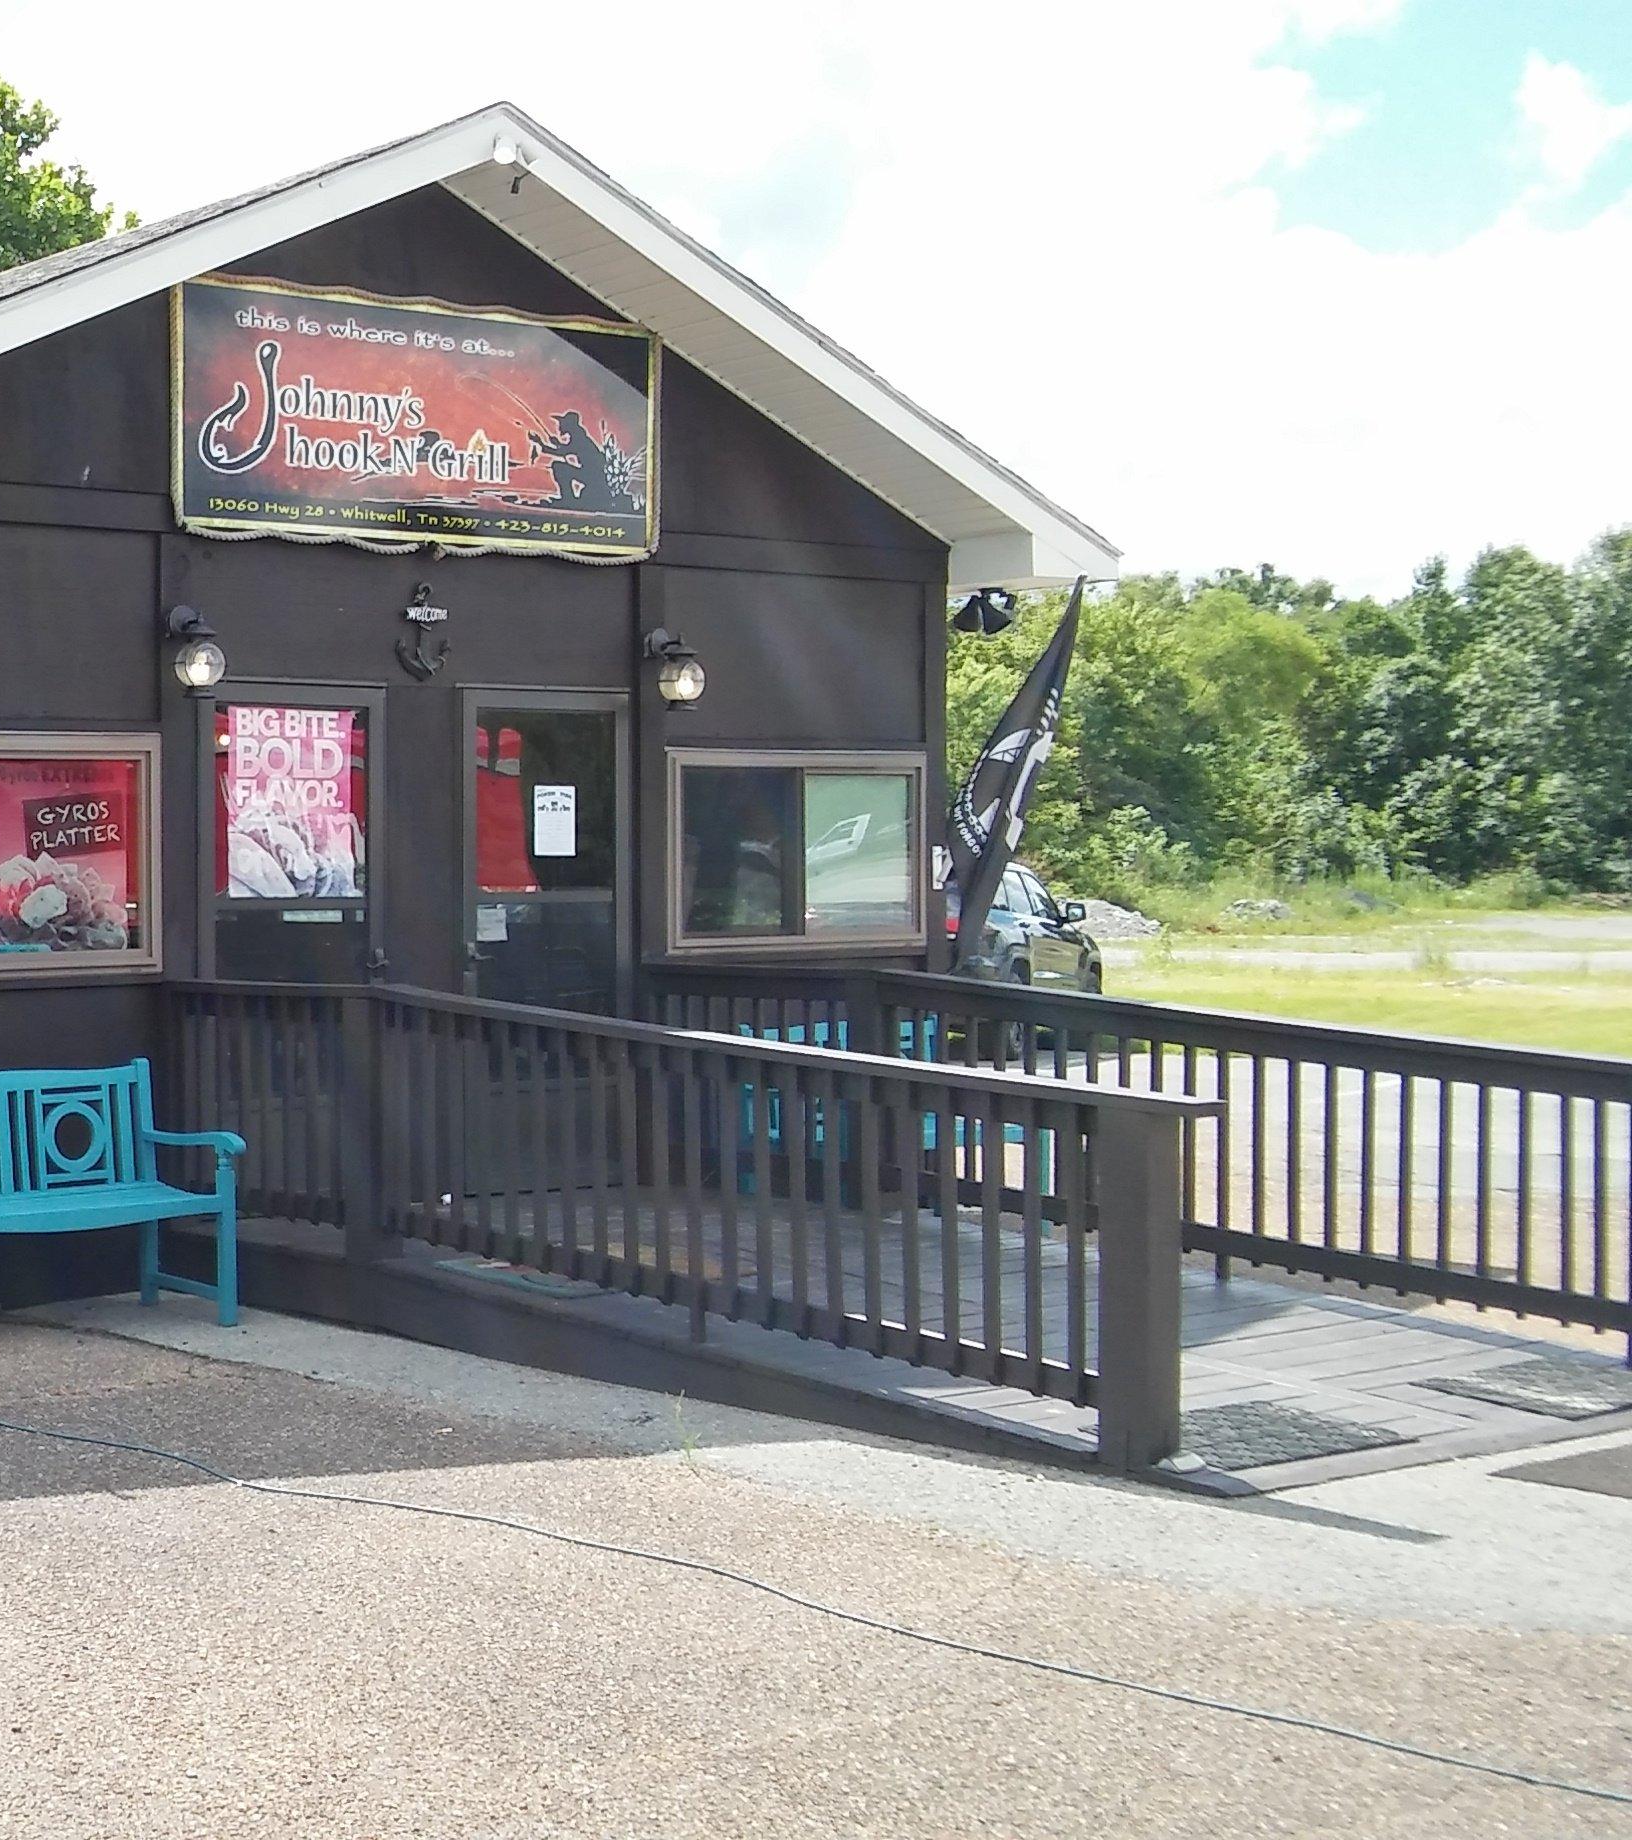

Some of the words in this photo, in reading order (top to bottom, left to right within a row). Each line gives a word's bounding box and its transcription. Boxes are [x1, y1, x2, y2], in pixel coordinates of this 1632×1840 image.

[235, 306, 290, 331] this
[296, 315, 321, 336] is
[327, 319, 408, 345] where
[414, 329, 455, 350] it's
[461, 339, 515, 358] at...
[199, 339, 425, 475] Johnny's
[429, 429, 511, 484] Grill
[208, 498, 260, 513] 13060
[264, 502, 300, 519] Hwy
[304, 505, 325, 517] 28
[341, 508, 412, 525] Whitwell,
[417, 513, 438, 525] Tn
[442, 516, 480, 529] 37397
[495, 518, 626, 538] 423-815-4014
[235, 708, 281, 737] BIG
[285, 710, 346, 739] BITE.
[235, 737, 344, 779] BOLD
[36, 801, 110, 825] GYROS
[235, 779, 344, 808] FLAVOR.
[30, 823, 121, 850] PLATTER
